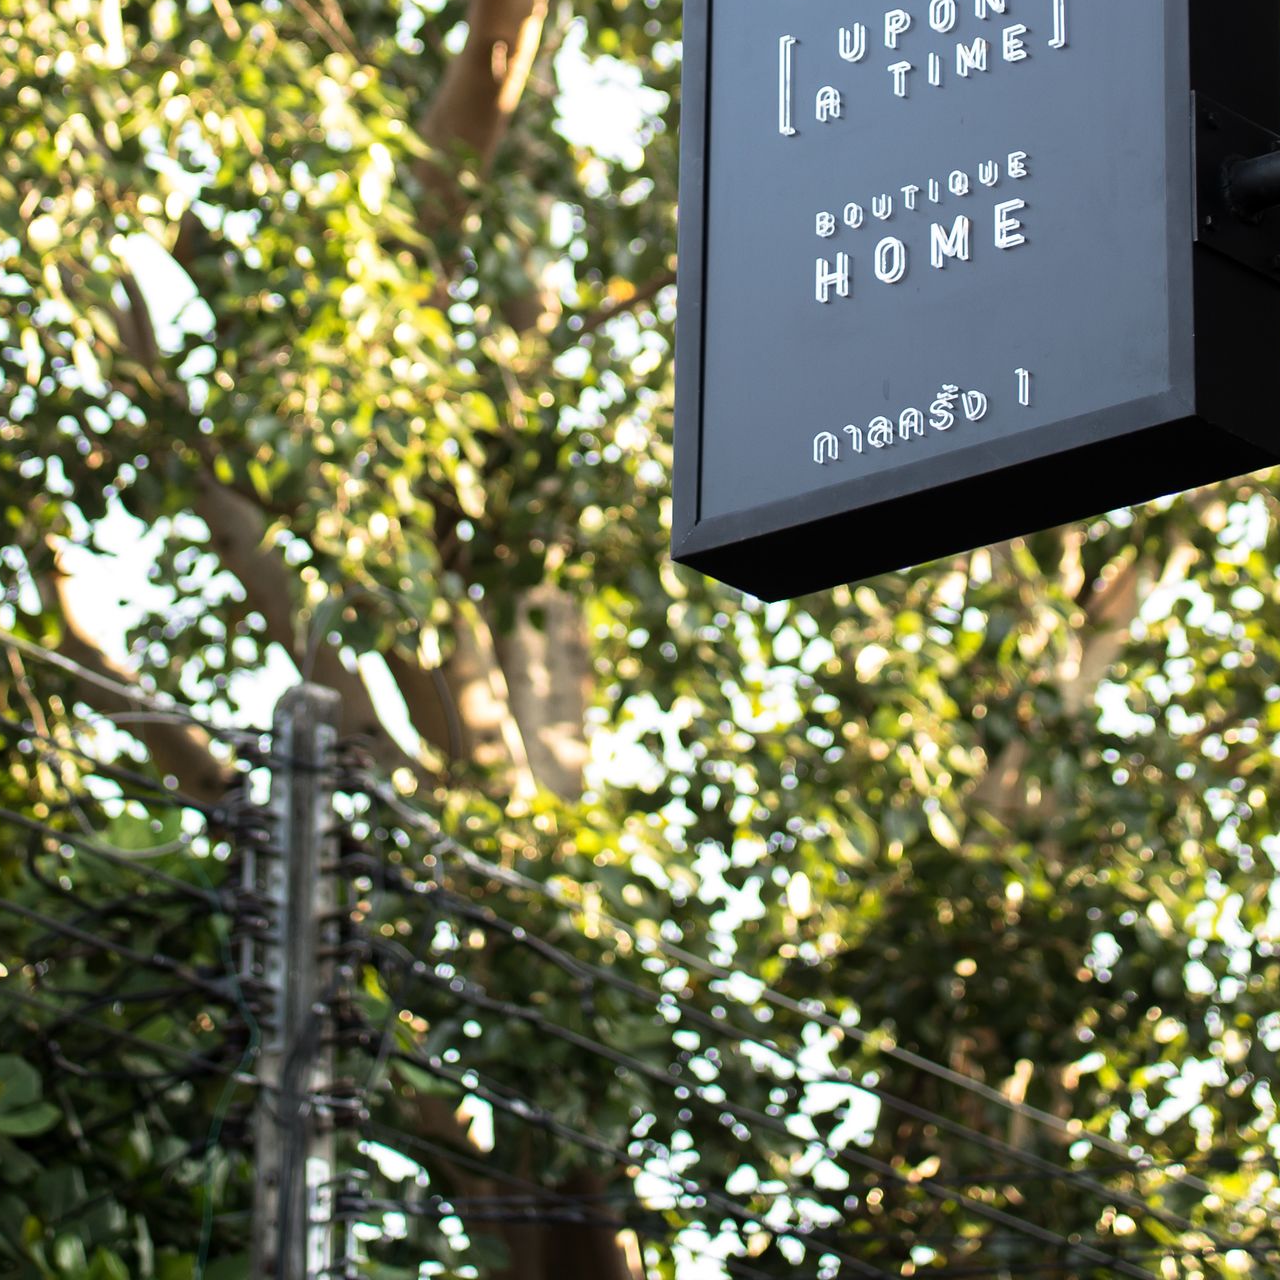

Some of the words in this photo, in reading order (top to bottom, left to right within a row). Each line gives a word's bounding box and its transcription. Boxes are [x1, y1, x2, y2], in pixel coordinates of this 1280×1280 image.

[815, 85, 841, 122] A
[887, 23, 1027, 97] TIME
[815, 150, 1028, 238] BOUTIQUE
[815, 198, 1025, 303] HOME
